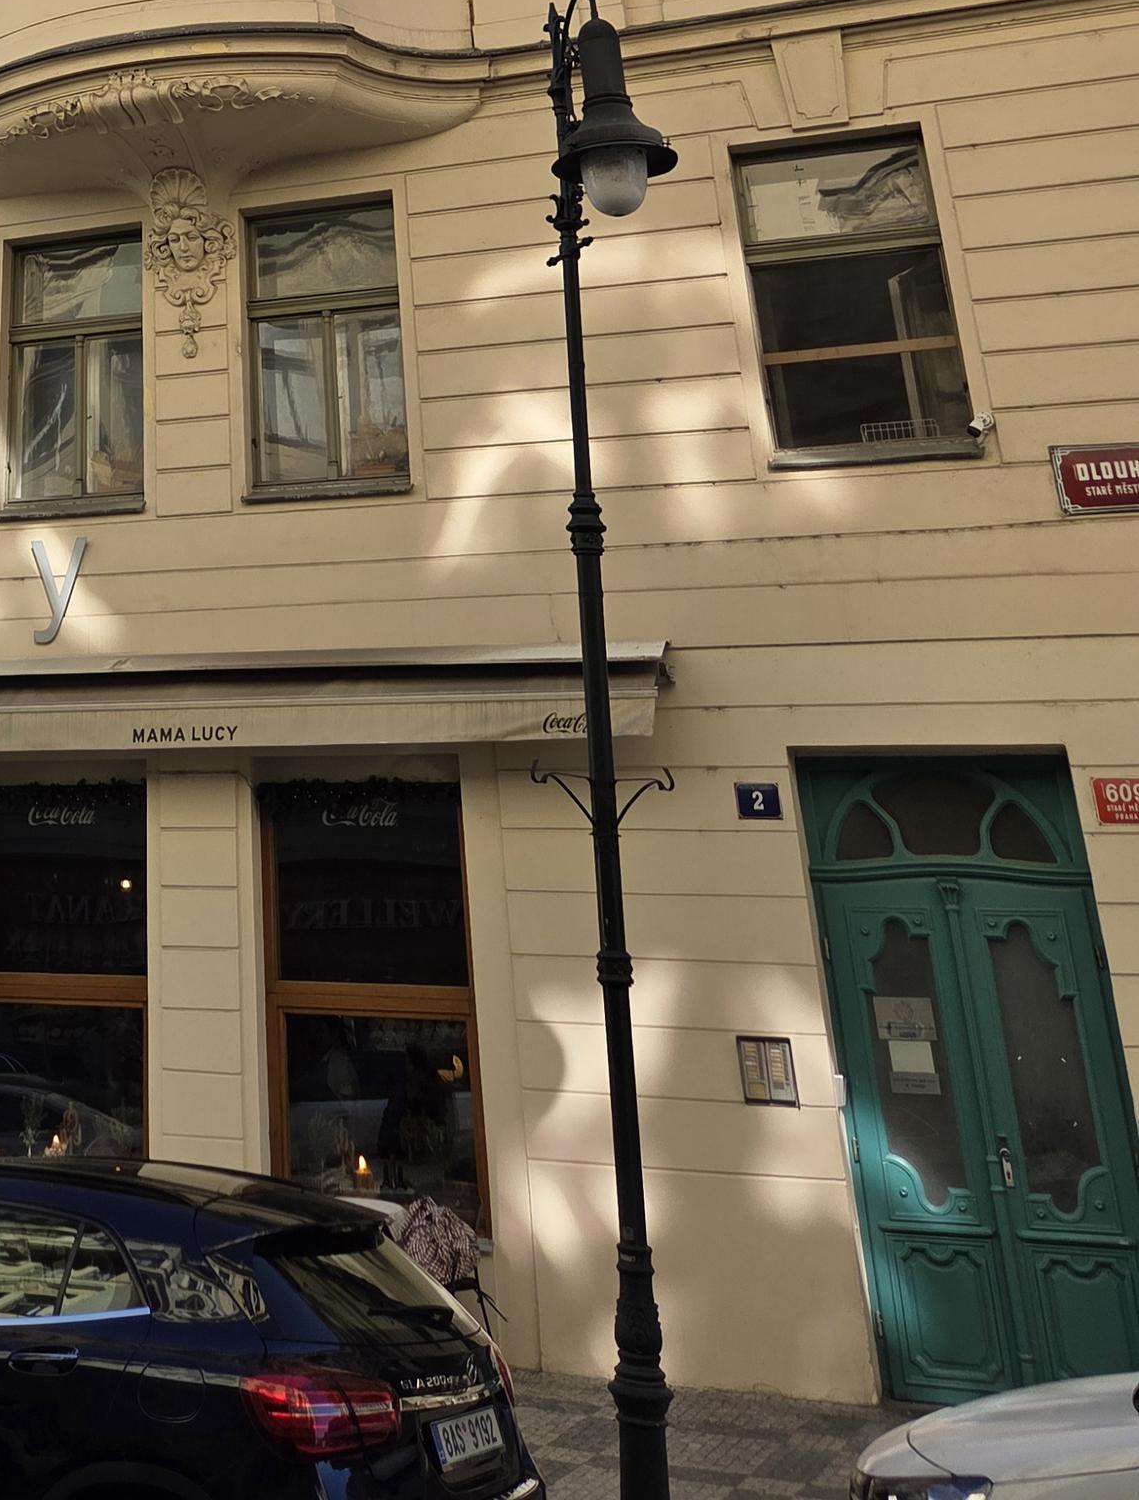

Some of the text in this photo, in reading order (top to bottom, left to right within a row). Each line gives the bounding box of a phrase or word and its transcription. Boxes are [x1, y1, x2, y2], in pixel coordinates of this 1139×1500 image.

[1085, 482, 1139, 496] STARÉ MĚST
[542, 711, 587, 733] Coca-C
[132, 726, 238, 743] MAMA LUCY
[752, 791, 765, 810] 2
[322, 800, 398, 826] Ca-Cola
[400, 1378, 425, 1389] GLA
[442, 1414, 497, 1457] 8AS 9192
